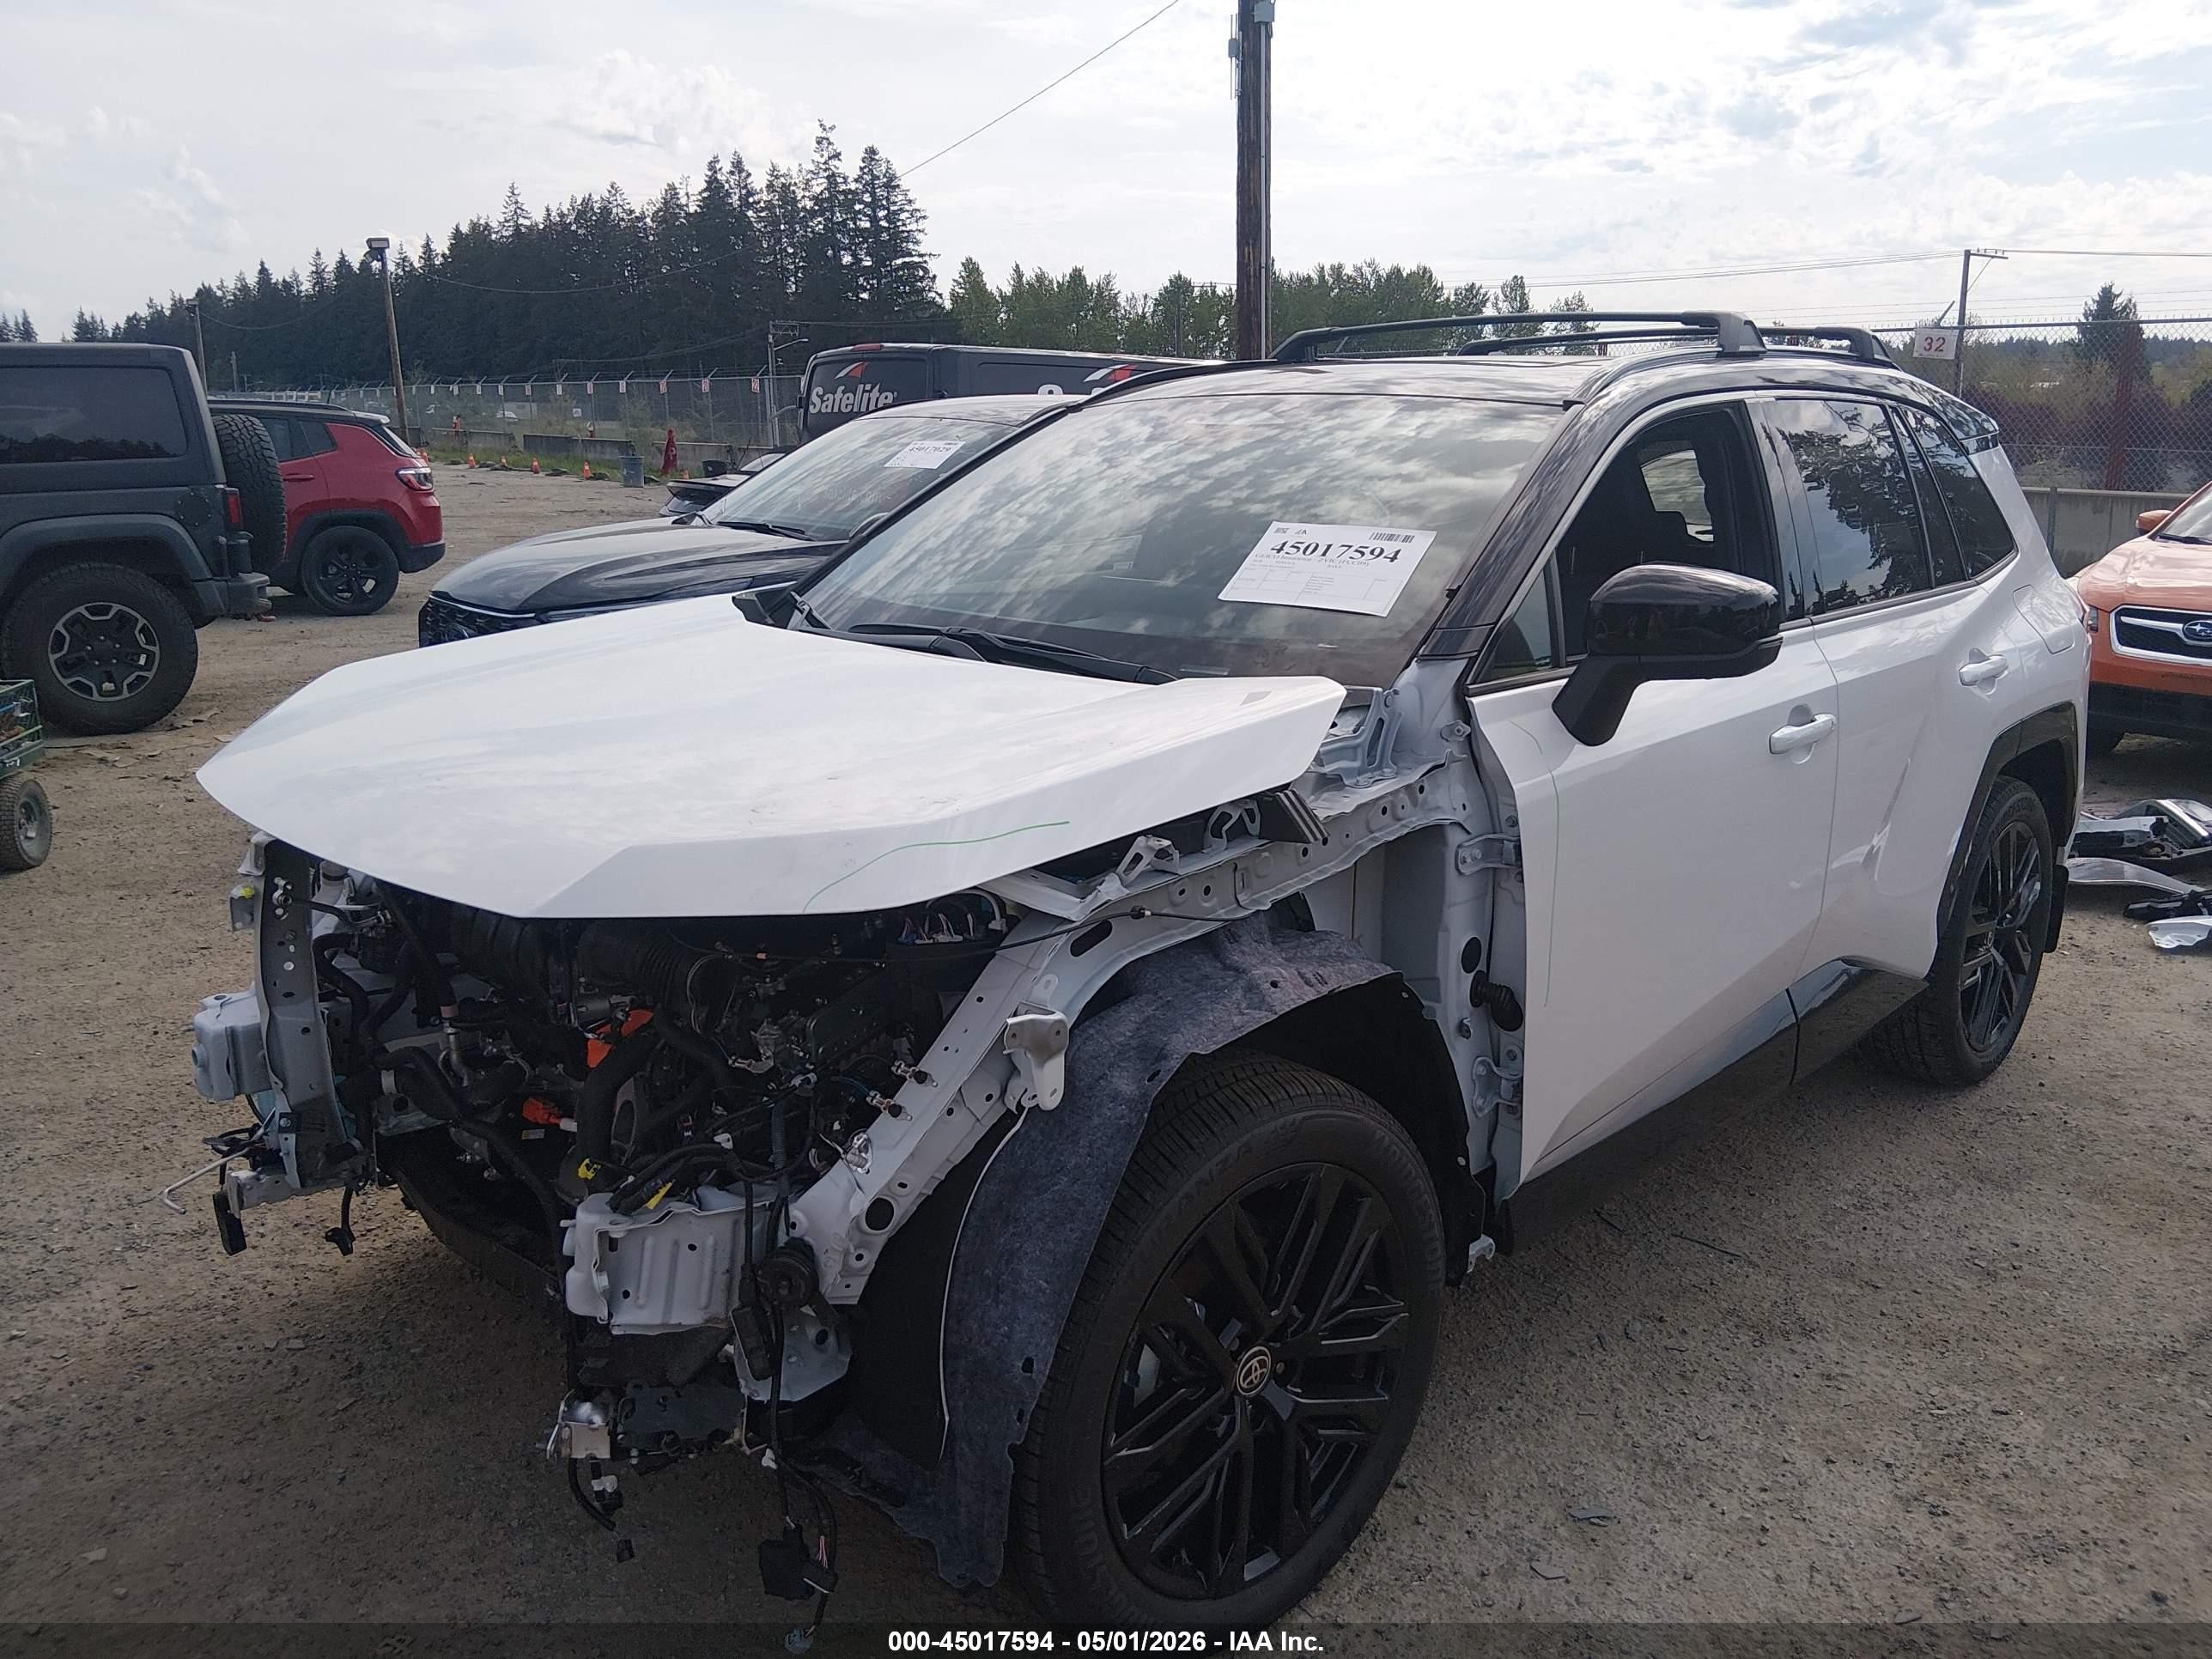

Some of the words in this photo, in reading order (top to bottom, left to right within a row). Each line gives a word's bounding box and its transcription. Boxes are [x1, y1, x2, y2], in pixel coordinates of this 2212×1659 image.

[1923, 336, 1946, 352] 32
[809, 383, 894, 414] Safelite
[1270, 540, 1402, 563] 45017594
